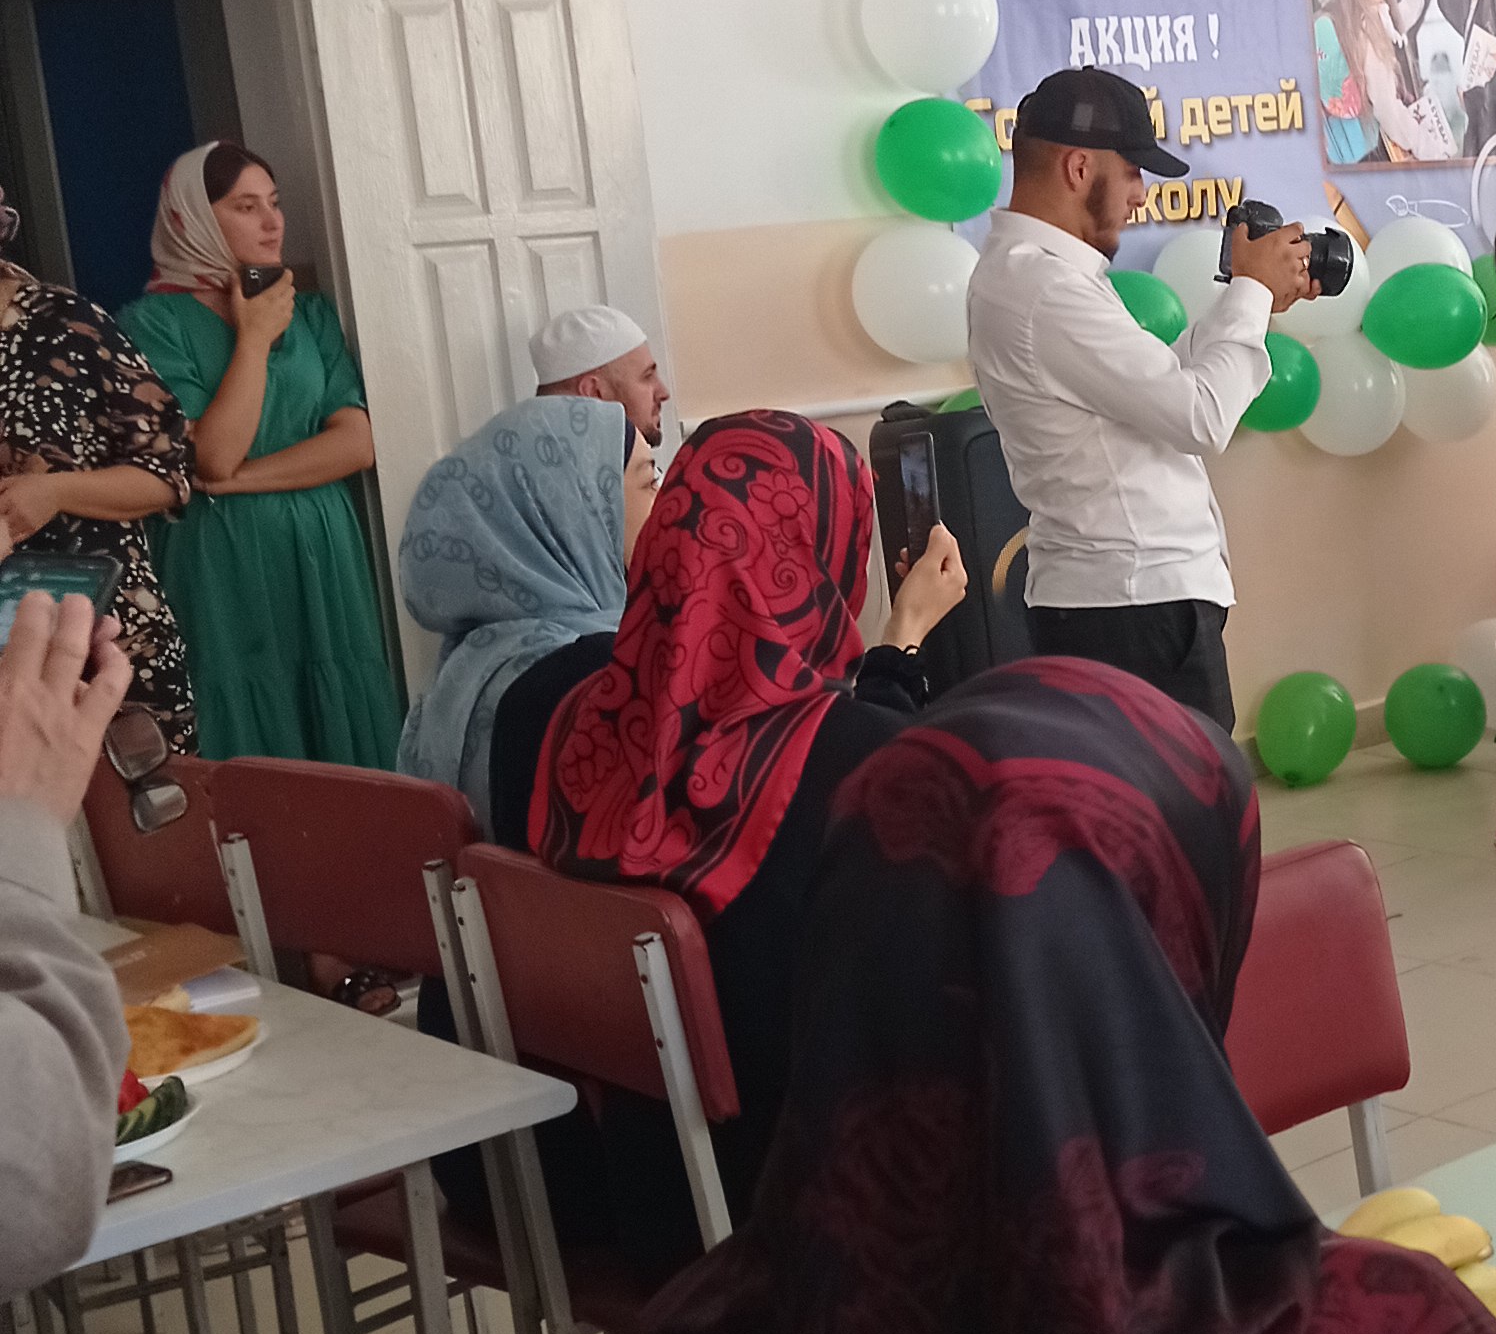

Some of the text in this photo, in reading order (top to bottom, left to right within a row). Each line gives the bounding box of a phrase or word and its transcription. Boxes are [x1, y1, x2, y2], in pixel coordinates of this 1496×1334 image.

[1069, 14, 1198, 70] АКЦИЯ
[1180, 78, 1304, 145] детей
[1126, 176, 1243, 227] колу
